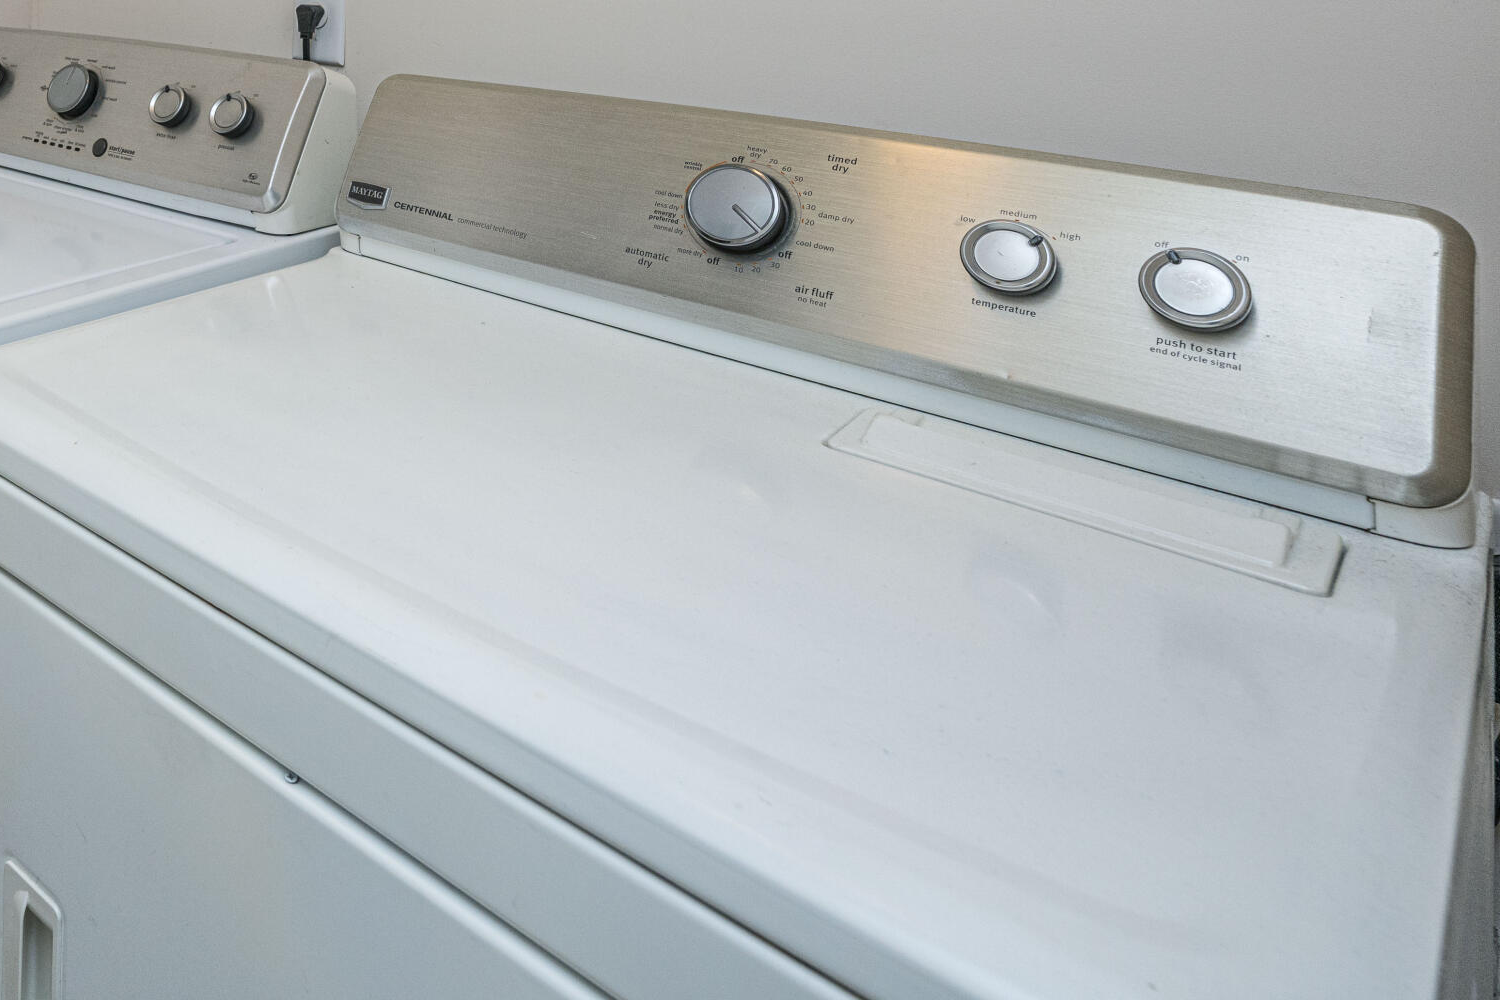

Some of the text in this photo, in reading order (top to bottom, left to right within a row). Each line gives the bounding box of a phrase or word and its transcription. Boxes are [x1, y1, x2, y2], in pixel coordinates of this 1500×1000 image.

[108, 145, 136, 156] start/pause
[747, 145, 768, 154] heavy
[750, 151, 762, 159] dry
[731, 155, 745, 164] off
[827, 154, 858, 166] timed
[781, 165, 792, 173] 60
[831, 163, 849, 175] dry
[794, 175, 804, 183] 50
[351, 184, 385, 200] MAYTAG
[667, 191, 683, 199] down
[668, 202, 680, 211] dry
[805, 203, 816, 211] 30
[648, 214, 680, 225] preferred
[653, 209, 677, 219] energy
[818, 211, 855, 225] damp dry
[960, 214, 976, 224] low
[999, 208, 1038, 221] medium
[393, 201, 528, 239] CENTENNIAL commercial technology
[653, 224, 685, 236] normal dry
[1059, 230, 1082, 242] high
[795, 239, 835, 253] cool down
[1154, 240, 1170, 249] off
[625, 245, 670, 262] automatic
[677, 247, 703, 258] more dry
[778, 250, 794, 260] off
[1235, 253, 1250, 263] on
[637, 257, 653, 269] dry
[706, 257, 721, 265] off
[770, 261, 781, 269] 30
[734, 266, 744, 274] 10
[794, 285, 835, 301] air fluff
[797, 296, 827, 308] no heat
[971, 297, 1037, 319] temperature
[1156, 336, 1237, 361] push to start
[1149, 344, 1242, 371] end of cycle signal
